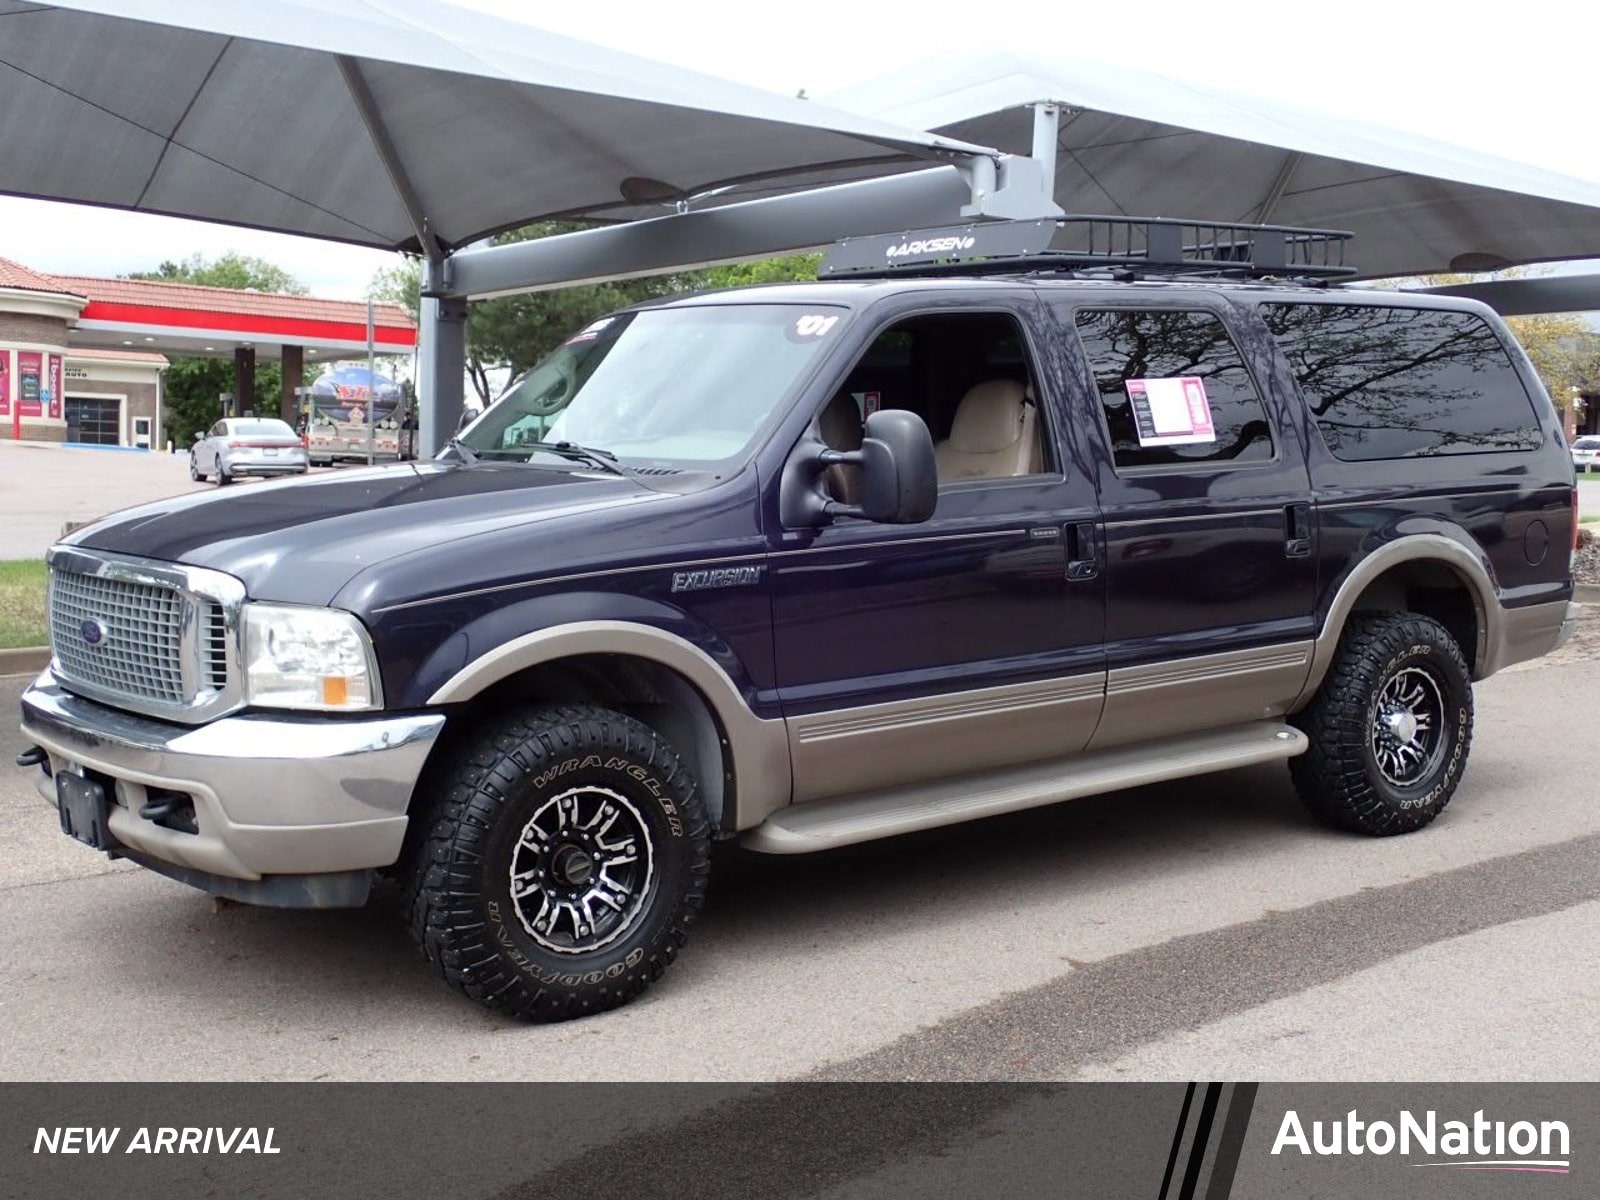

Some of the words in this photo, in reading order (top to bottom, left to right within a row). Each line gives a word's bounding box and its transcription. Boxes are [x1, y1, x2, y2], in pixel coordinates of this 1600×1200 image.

[893, 236, 967, 257] ARKSEN
[671, 566, 761, 592] EXCURSION
[533, 755, 684, 838] WRANGLER
[488, 901, 644, 986] GOODYEAR
